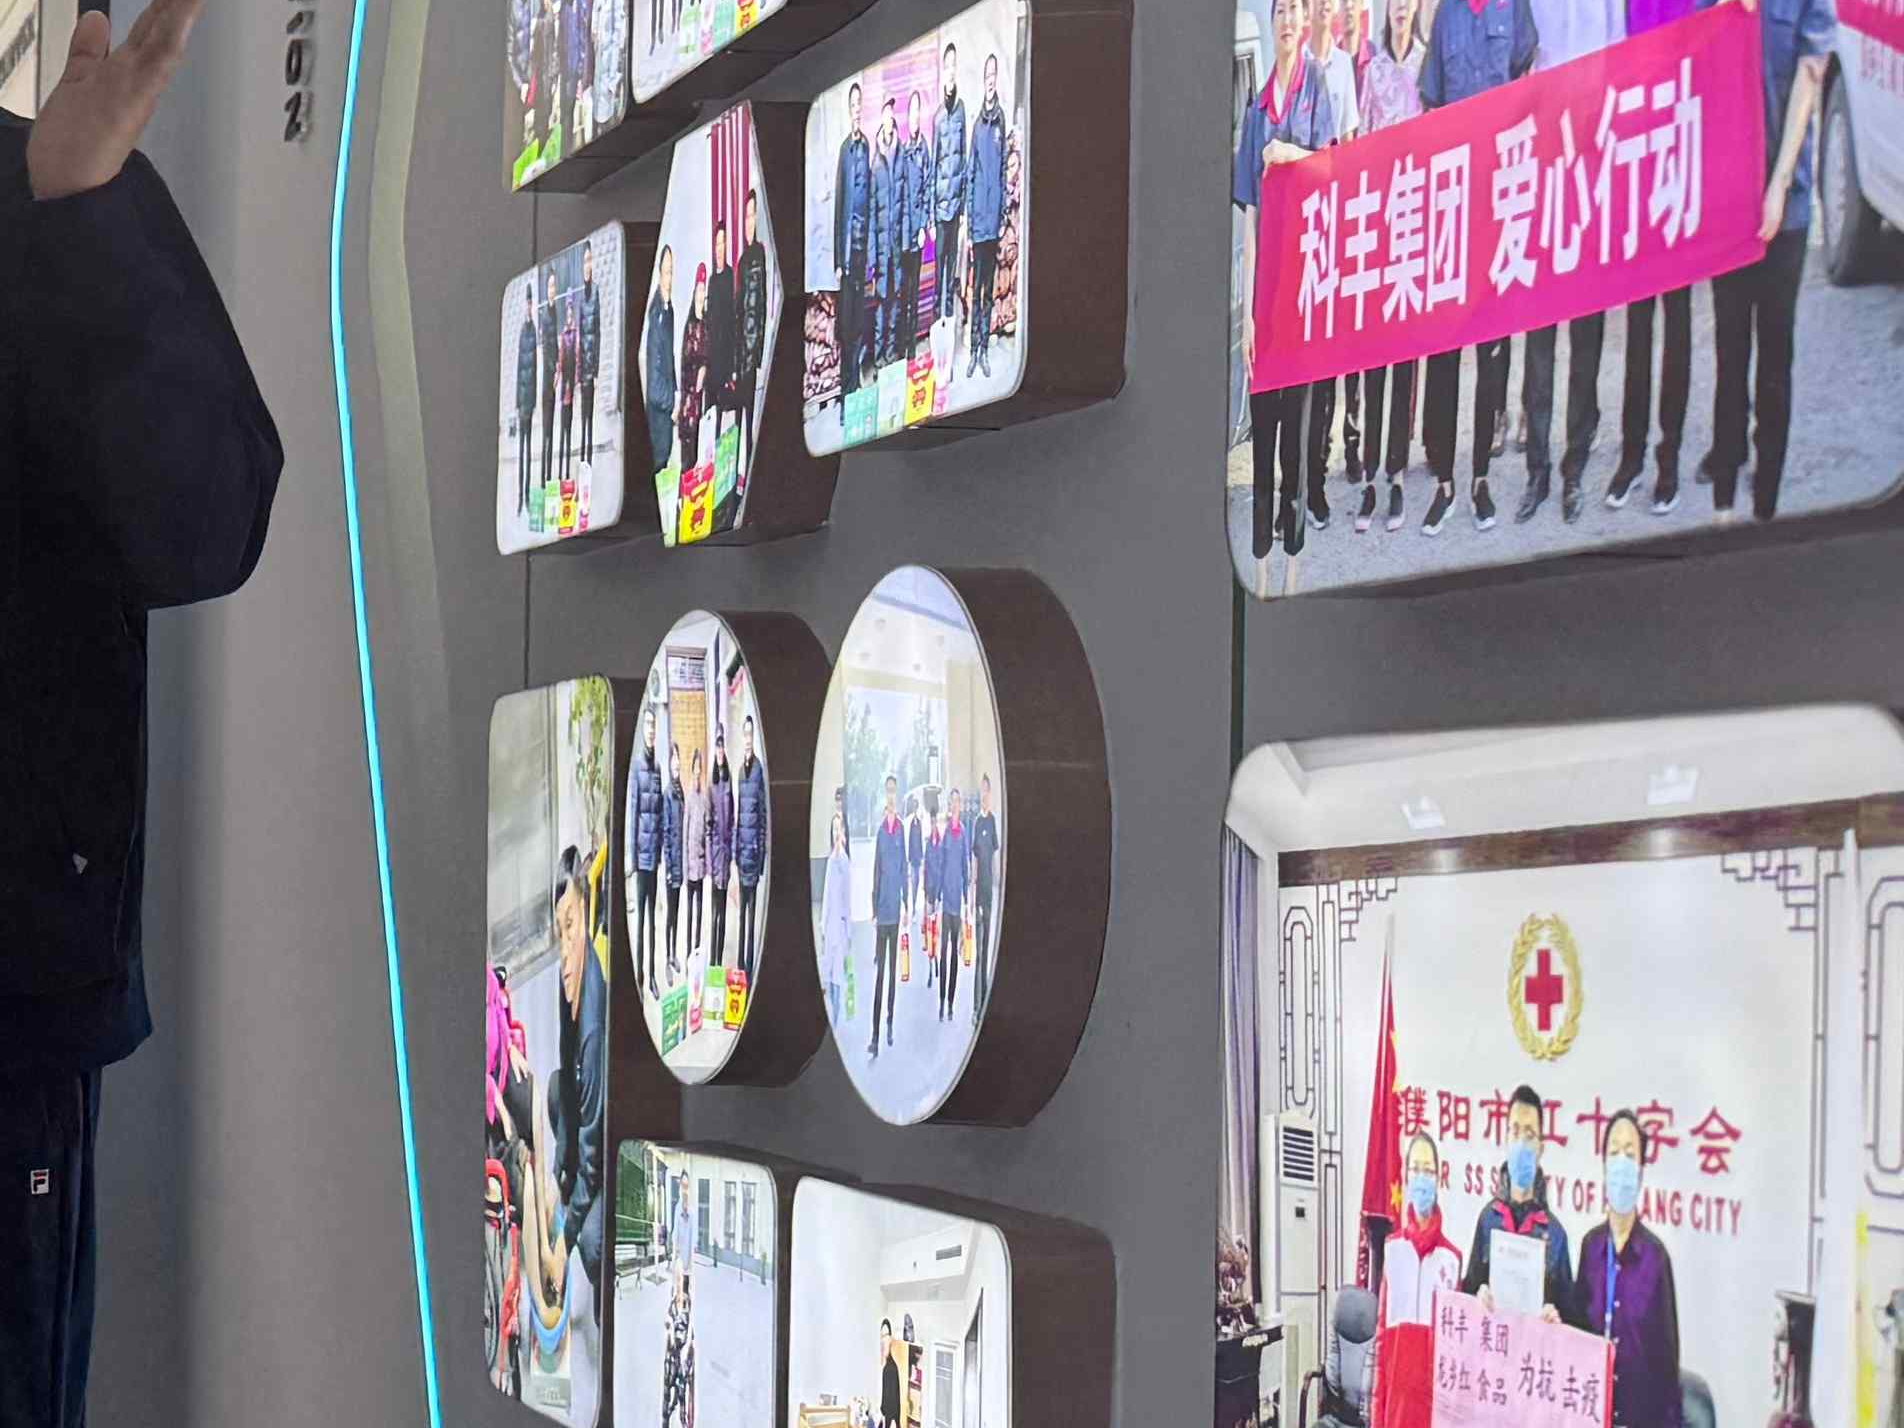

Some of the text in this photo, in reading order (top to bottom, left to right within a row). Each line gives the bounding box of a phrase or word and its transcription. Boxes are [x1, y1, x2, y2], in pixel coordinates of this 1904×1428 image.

[1297, 57, 1703, 342] 科丰集团 爱心行动
[1572, 1179, 1595, 1213] OF
[1691, 1192, 1742, 1236] CITY
